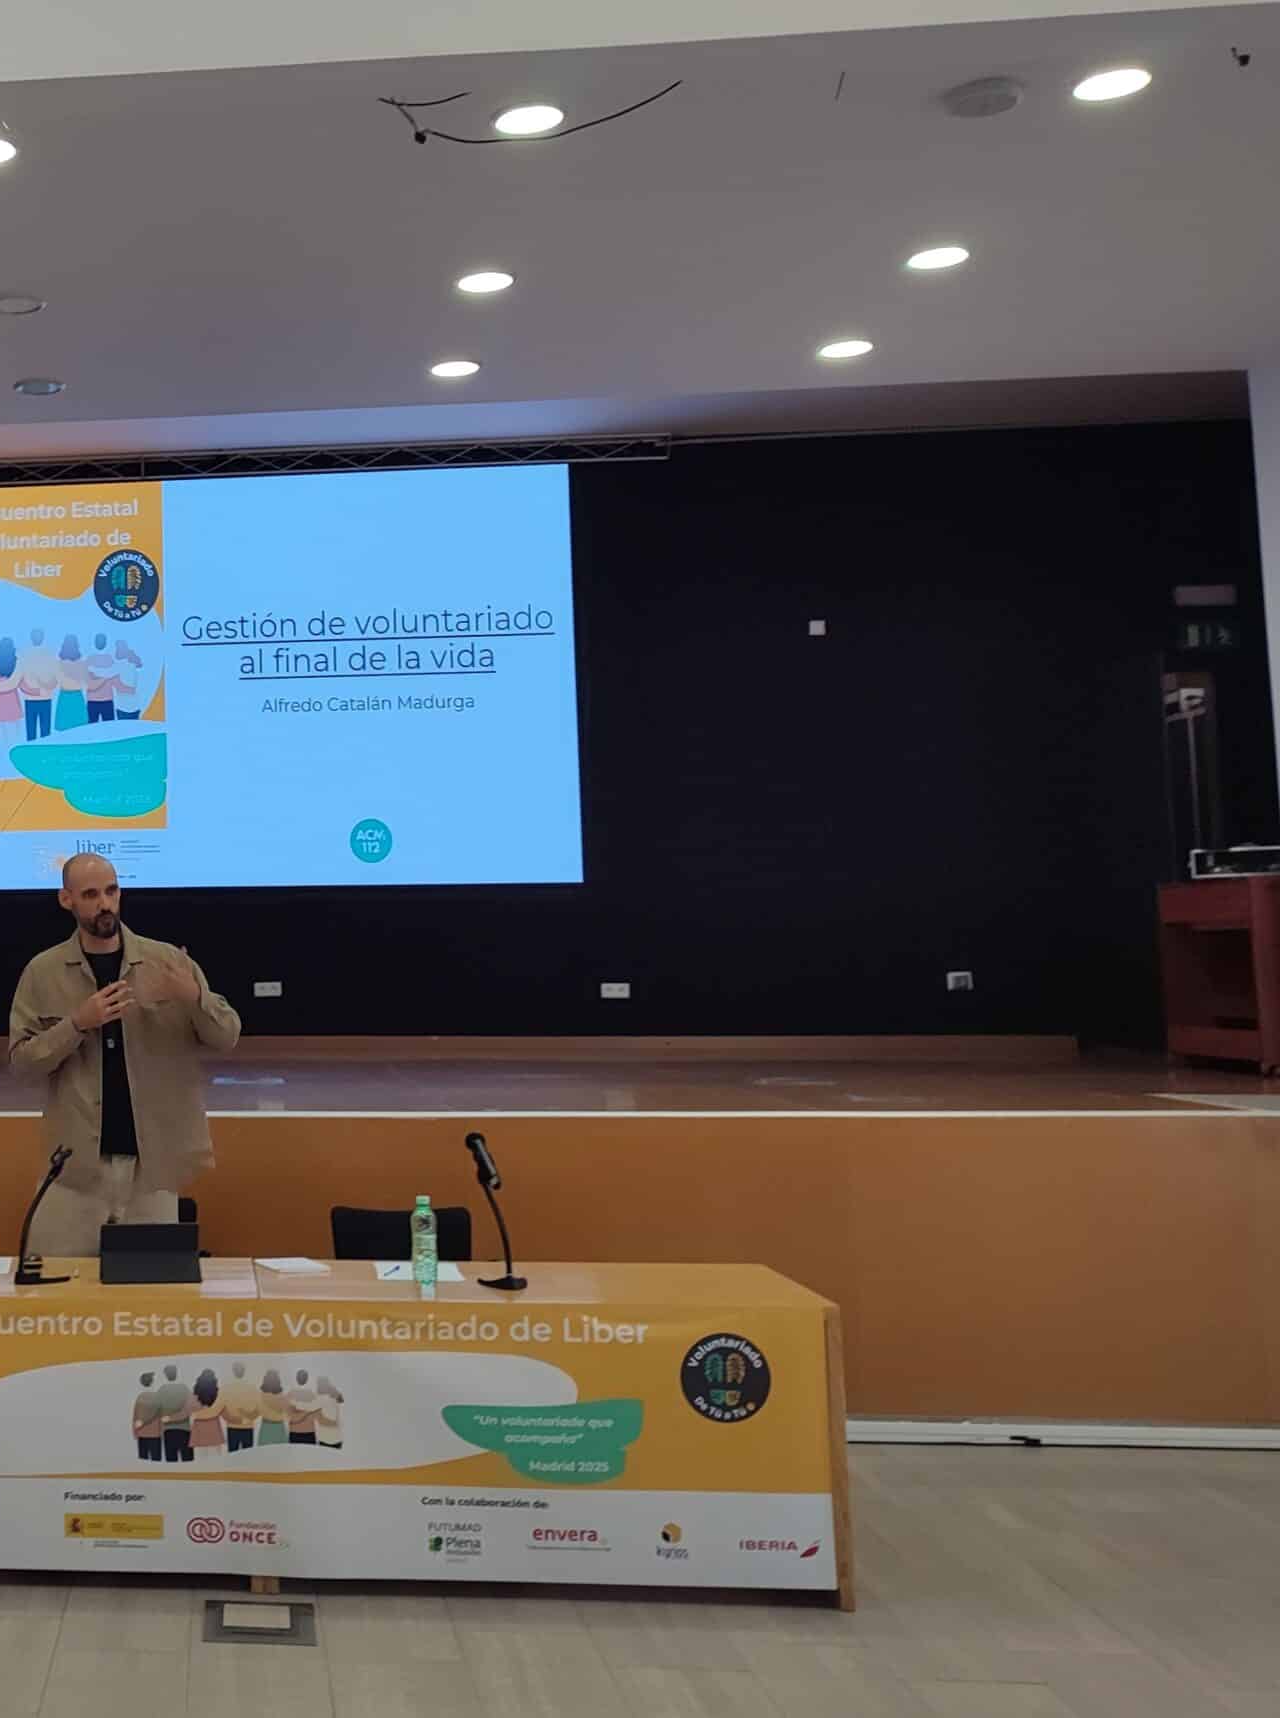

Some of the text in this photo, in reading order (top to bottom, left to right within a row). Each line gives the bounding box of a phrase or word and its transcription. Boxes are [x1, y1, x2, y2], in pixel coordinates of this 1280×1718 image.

[70, 498, 139, 518] Estatal
[106, 530, 132, 546] de
[14, 560, 64, 579] Liber
[98, 552, 154, 577] Voluntariado
[181, 603, 554, 642] Gestión de voluntariado
[239, 641, 496, 675] al final de la vida
[261, 694, 476, 714] Alfredo Catalán Madurga
[113, 1311, 223, 1337] Estatal
[233, 1312, 273, 1338] de
[283, 1312, 500, 1341] Voluntariado
[509, 1316, 553, 1344] de
[563, 1316, 649, 1345] Liber
[687, 1337, 763, 1369] Voluntariado
[587, 1418, 614, 1430] que
[529, 1461, 609, 1473] Madrid 2025
[64, 1490, 122, 1501] Financiado
[421, 1497, 443, 1506] Con
[445, 1496, 455, 1507] la
[457, 1498, 530, 1509] colaboración
[229, 1531, 276, 1545] ONCE
[445, 1537, 481, 1549] Plena
[532, 1528, 598, 1542] envera
[739, 1540, 798, 1552] IBERIA
